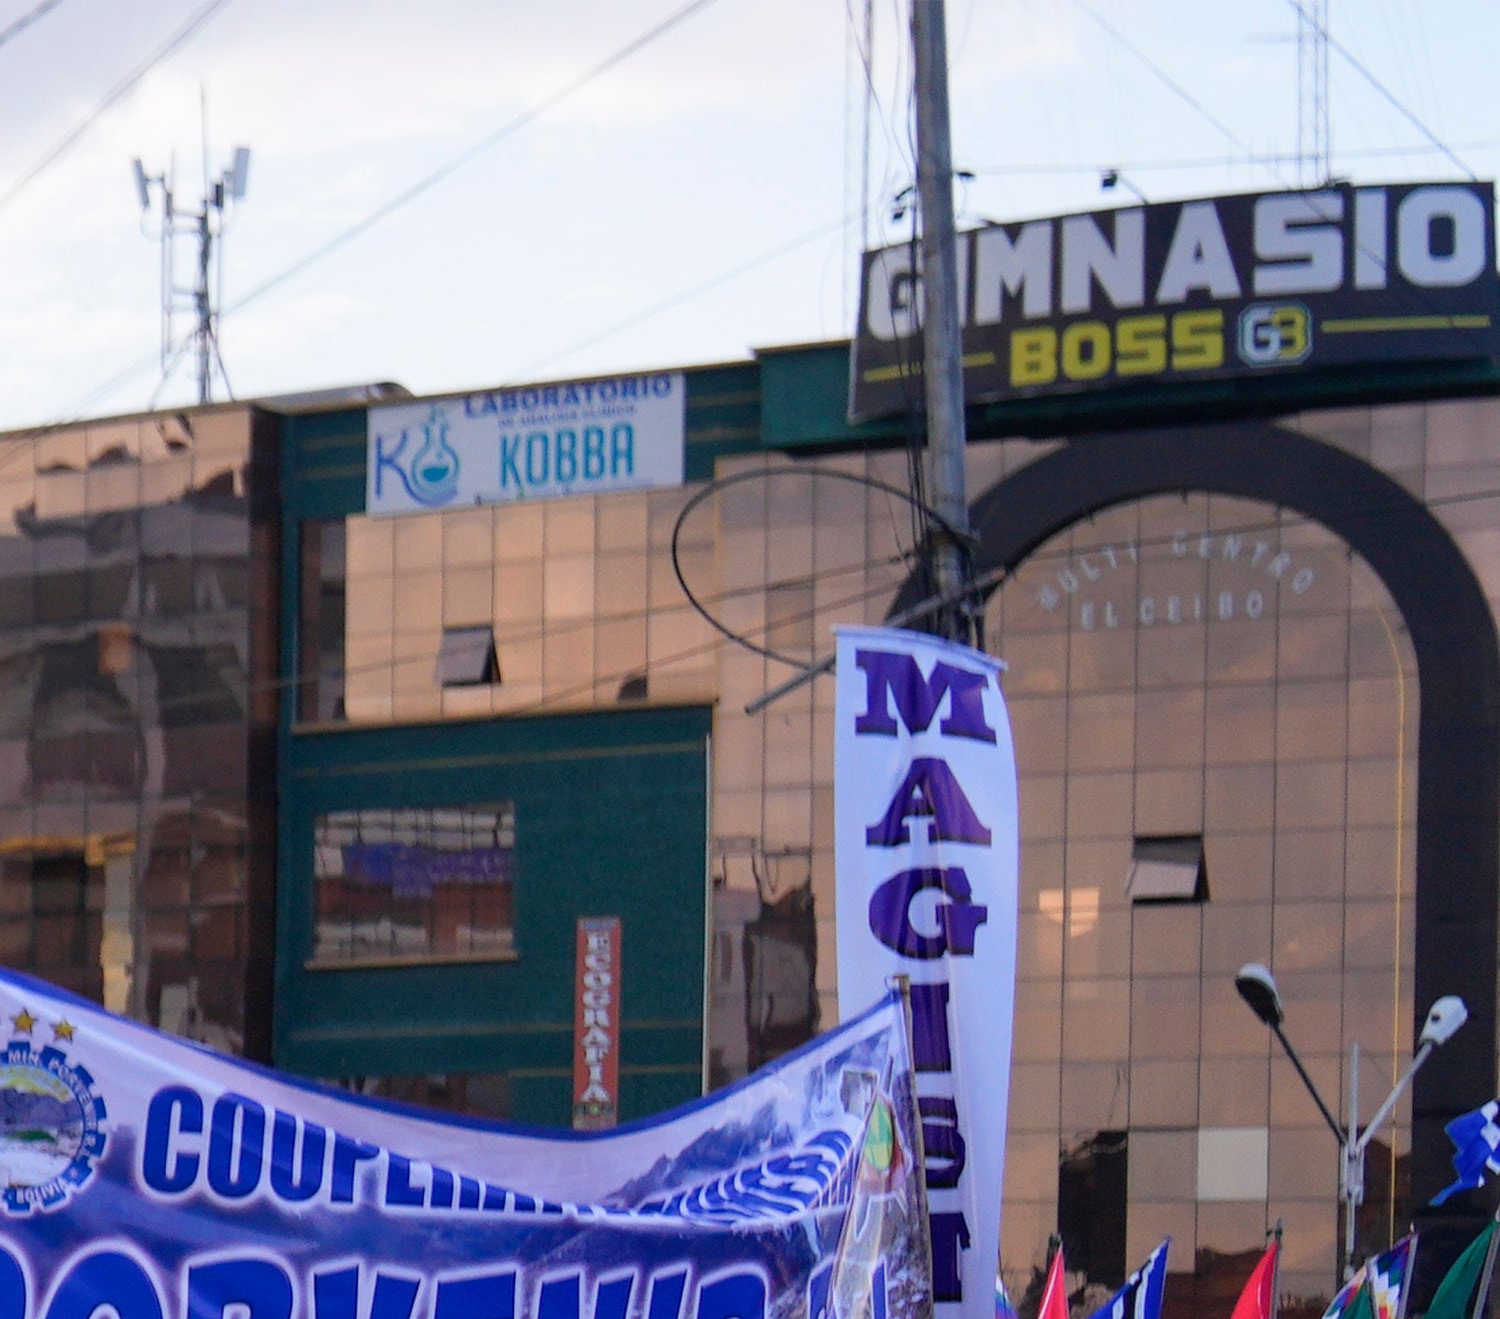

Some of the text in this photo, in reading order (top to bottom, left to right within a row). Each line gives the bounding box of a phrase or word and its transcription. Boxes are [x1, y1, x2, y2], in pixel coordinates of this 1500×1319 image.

[1010, 309, 1224, 388] BOSS
[500, 422, 635, 488] KOBBA
[1173, 530, 1314, 595] CENTRO
[1082, 596, 1117, 628] EL
